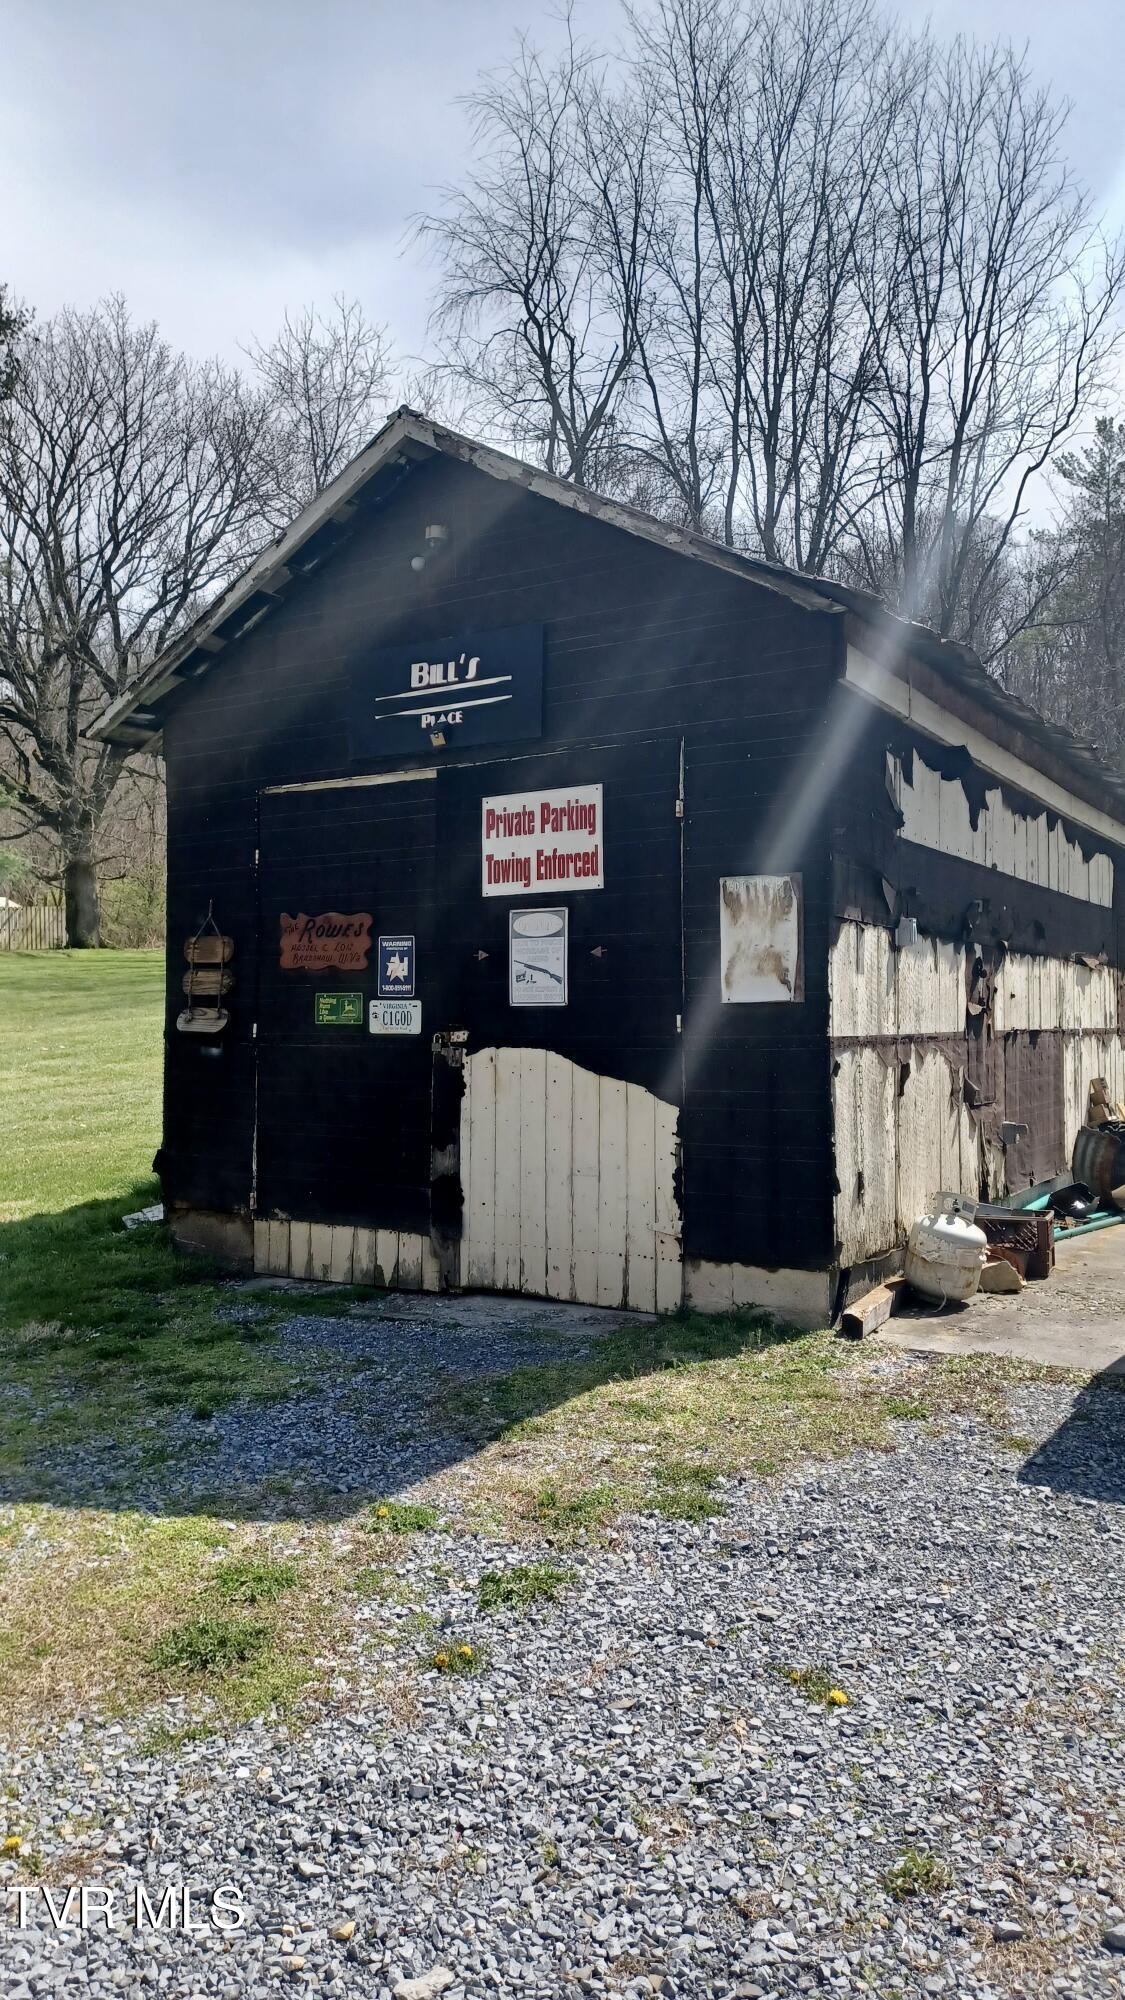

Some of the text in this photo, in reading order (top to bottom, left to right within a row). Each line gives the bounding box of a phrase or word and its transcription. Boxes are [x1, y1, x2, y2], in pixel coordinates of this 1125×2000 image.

[485, 799, 597, 839] Private Parking
[485, 844, 599, 888] Towing Enforced
